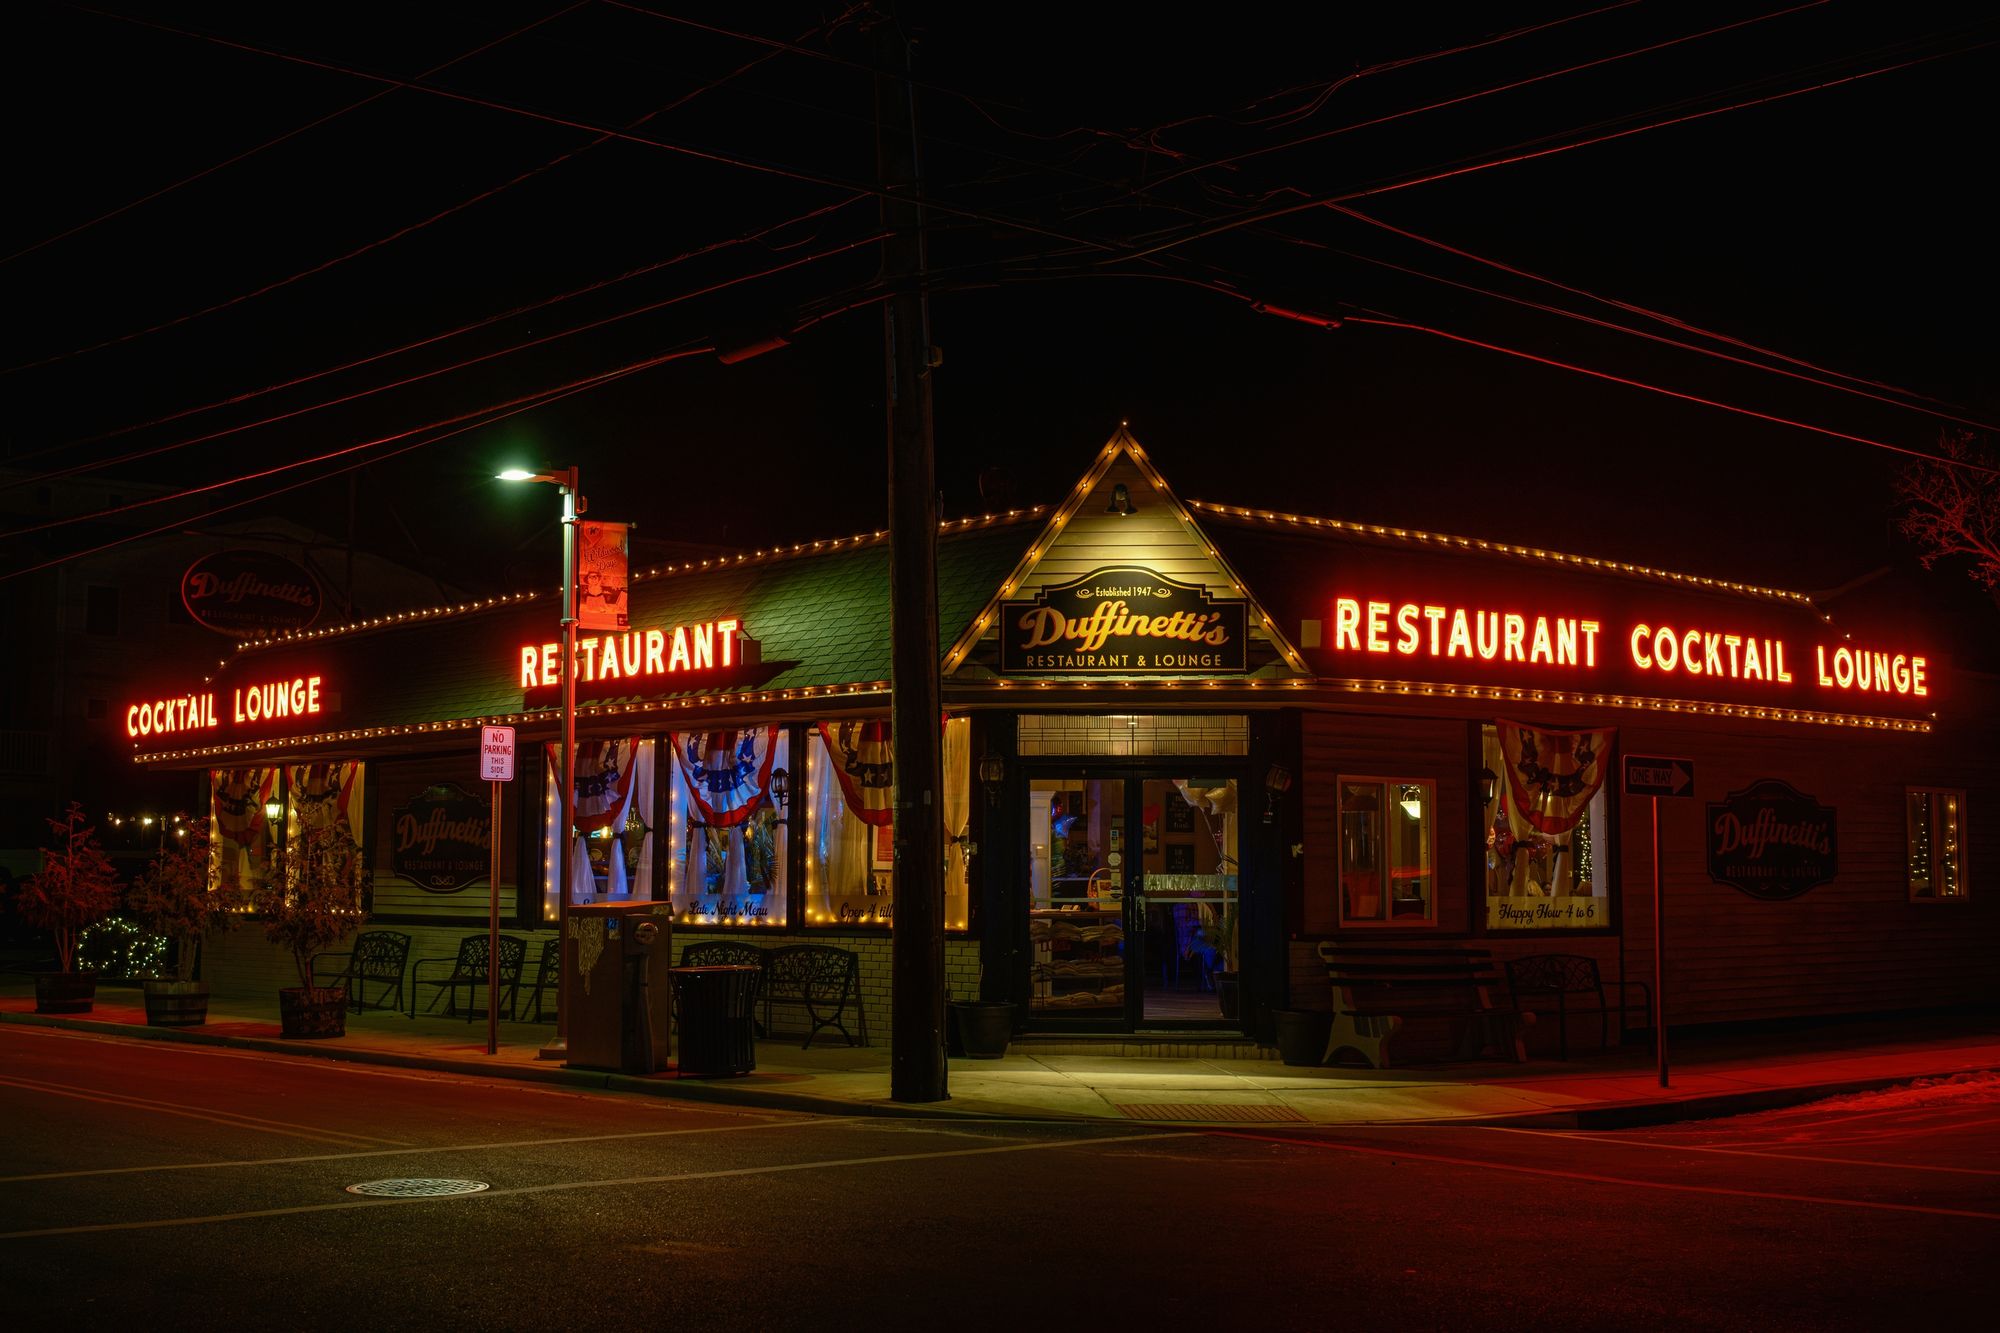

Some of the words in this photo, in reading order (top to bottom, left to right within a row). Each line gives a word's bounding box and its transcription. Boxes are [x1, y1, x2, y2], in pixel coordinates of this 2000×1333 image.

[190, 570, 314, 607] Duffinetti's
[1095, 587, 1131, 597] Established
[1133, 587, 1152, 597] 1947
[1016, 600, 1231, 653] Duffinetti's
[1335, 597, 1600, 668] RESTAURANT
[1026, 655, 1129, 667] RESTAURANT
[1137, 655, 1147, 667] &
[1155, 654, 1222, 667] LOUNGE
[1630, 623, 1793, 683] COCKTAIL
[1815, 645, 1928, 697] LOUNGE
[127, 692, 218, 737] COCKTAIL
[234, 676, 321, 724] LOUNGE
[492, 733, 505, 743] NO
[484, 745, 512, 756] PARKING
[491, 757, 505, 765] THIS
[490, 766, 504, 774] SIDE
[1631, 767, 1650, 784] ONE
[1654, 768, 1673, 785] WAY
[689, 900, 708, 915] Late
[711, 900, 737, 922] Night
[739, 901, 768, 916] Menu
[840, 902, 865, 923] Open
[868, 902, 877, 918] 4
[1499, 904, 1534, 924] Happy
[1537, 904, 1562, 918] Hour
[1564, 903, 1574, 918] 4
[1576, 906, 1584, 918] to
[1586, 904, 1595, 918] 6
